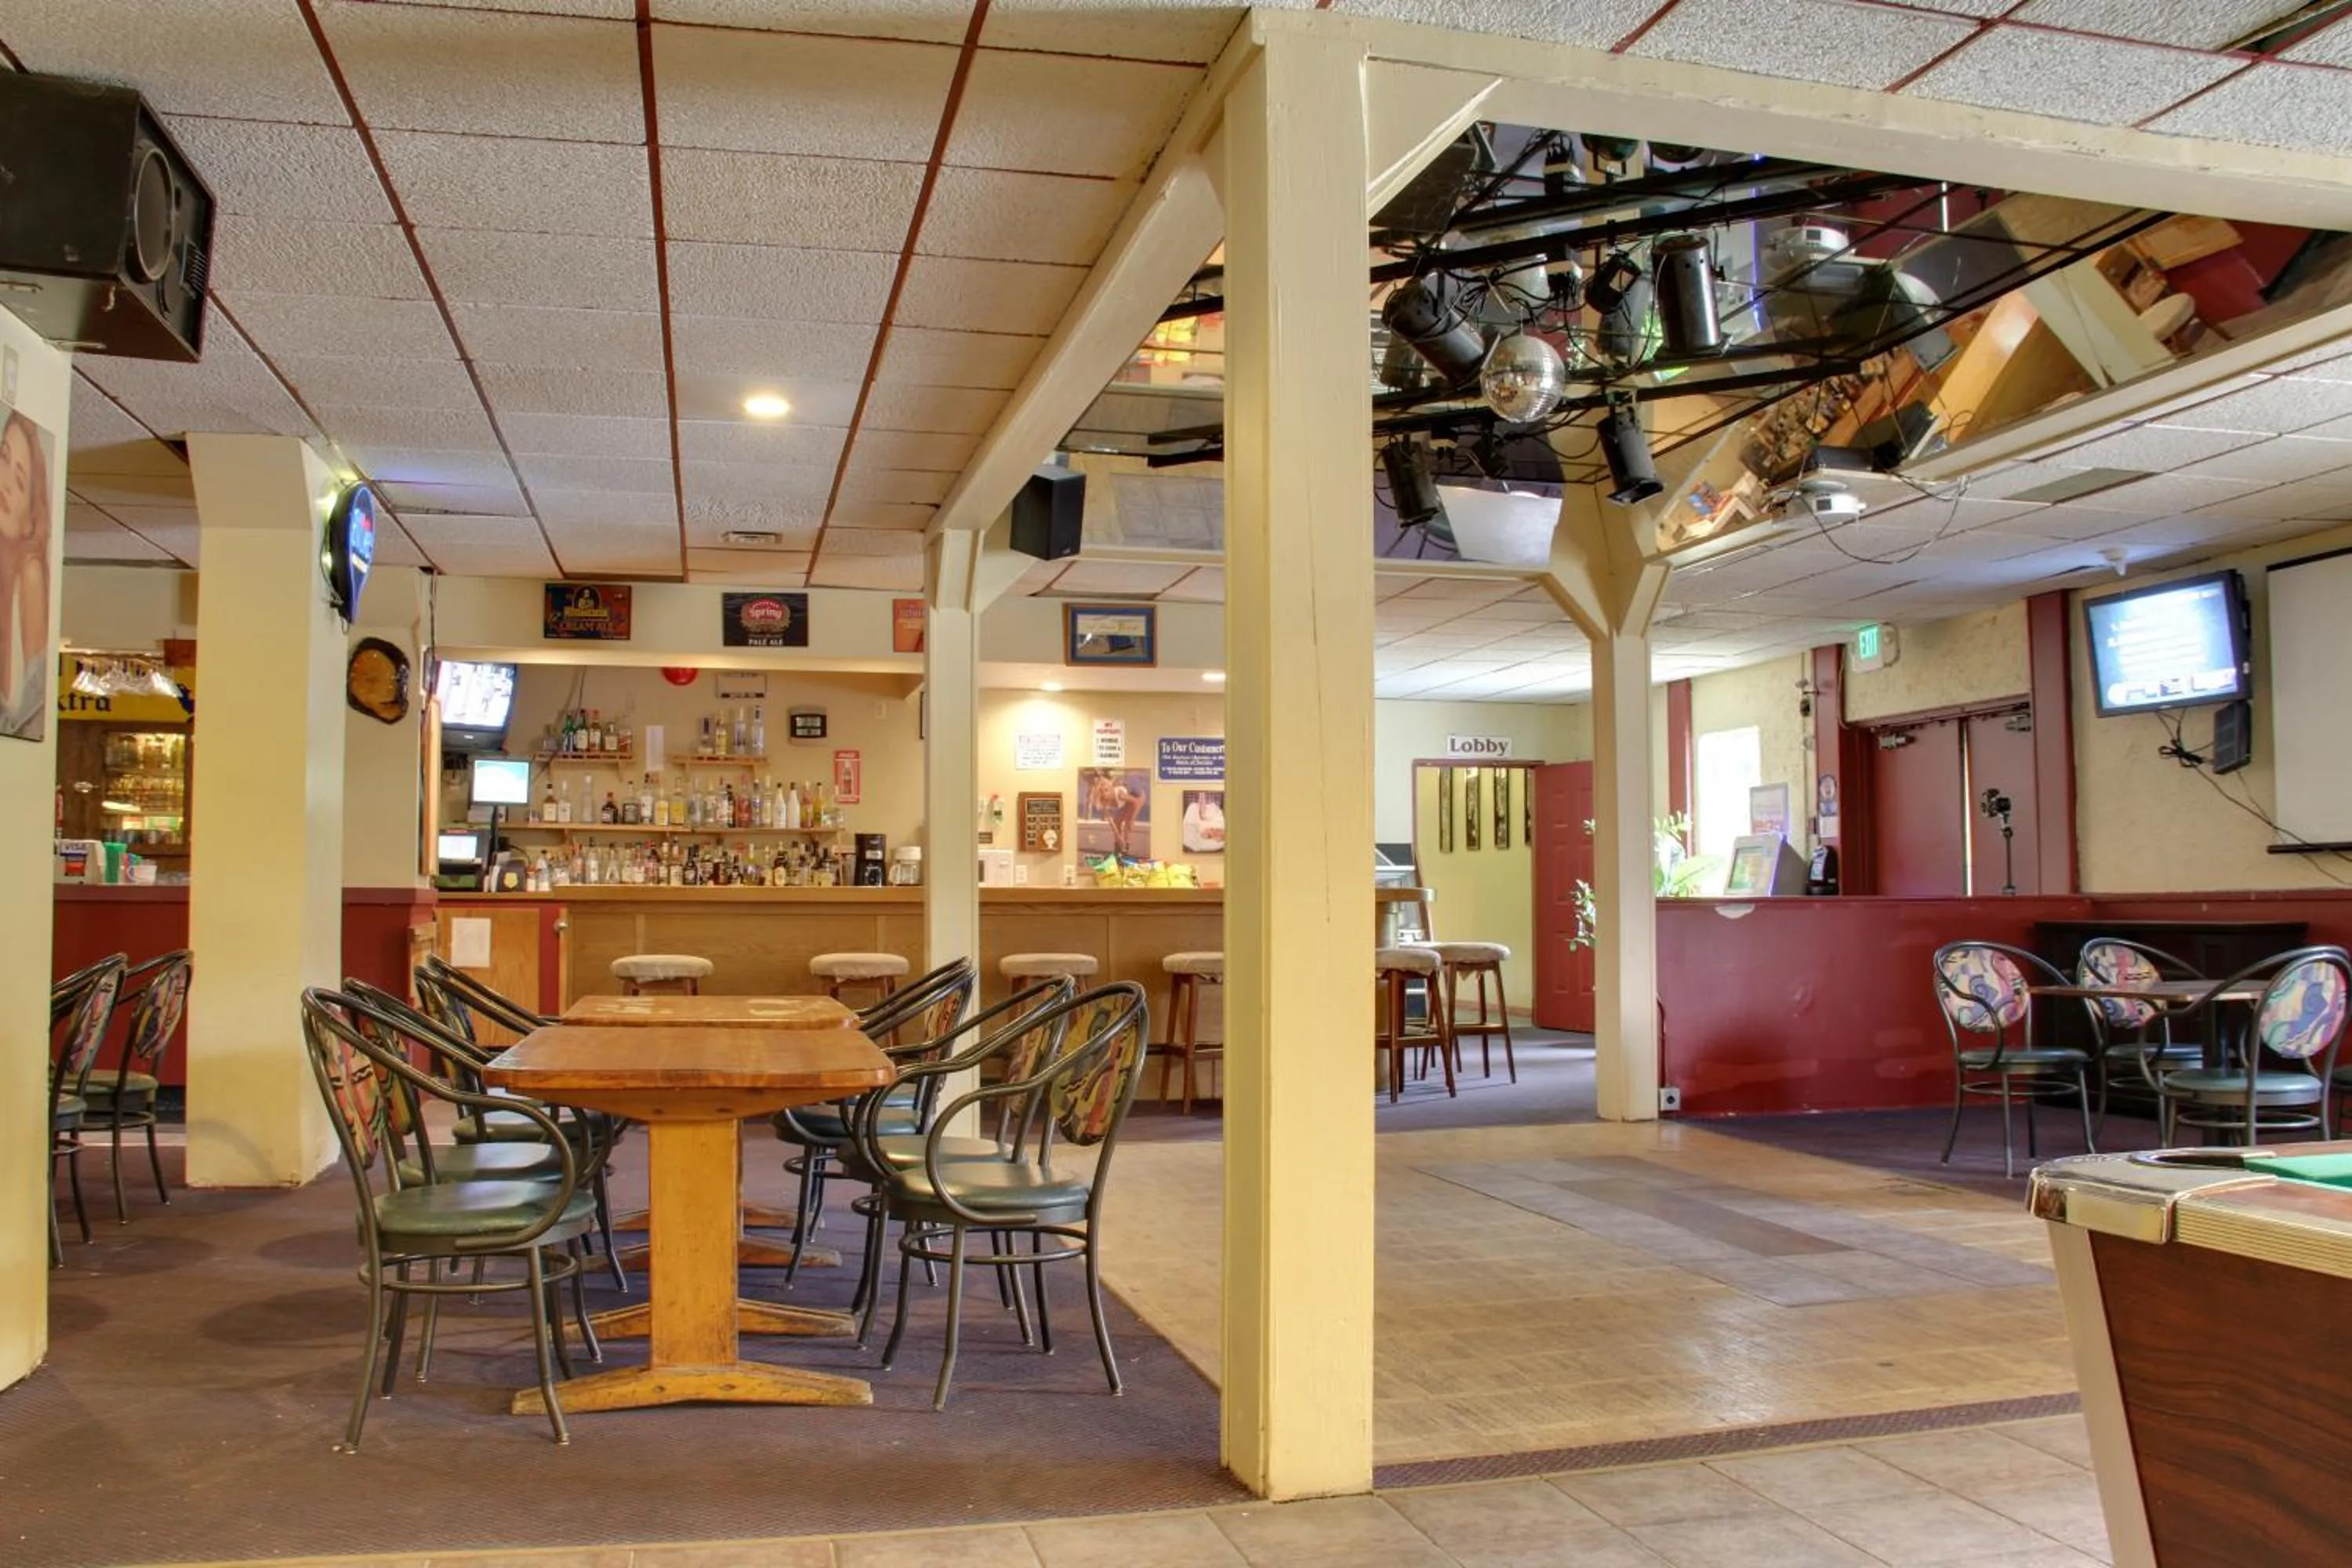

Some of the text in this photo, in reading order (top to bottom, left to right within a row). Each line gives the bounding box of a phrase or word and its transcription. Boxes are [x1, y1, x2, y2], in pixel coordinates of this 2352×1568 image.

[1860, 629, 1877, 659] EXIT
[1162, 741, 1225, 753] To Our Customer
[1450, 738, 1508, 756] Lobby
